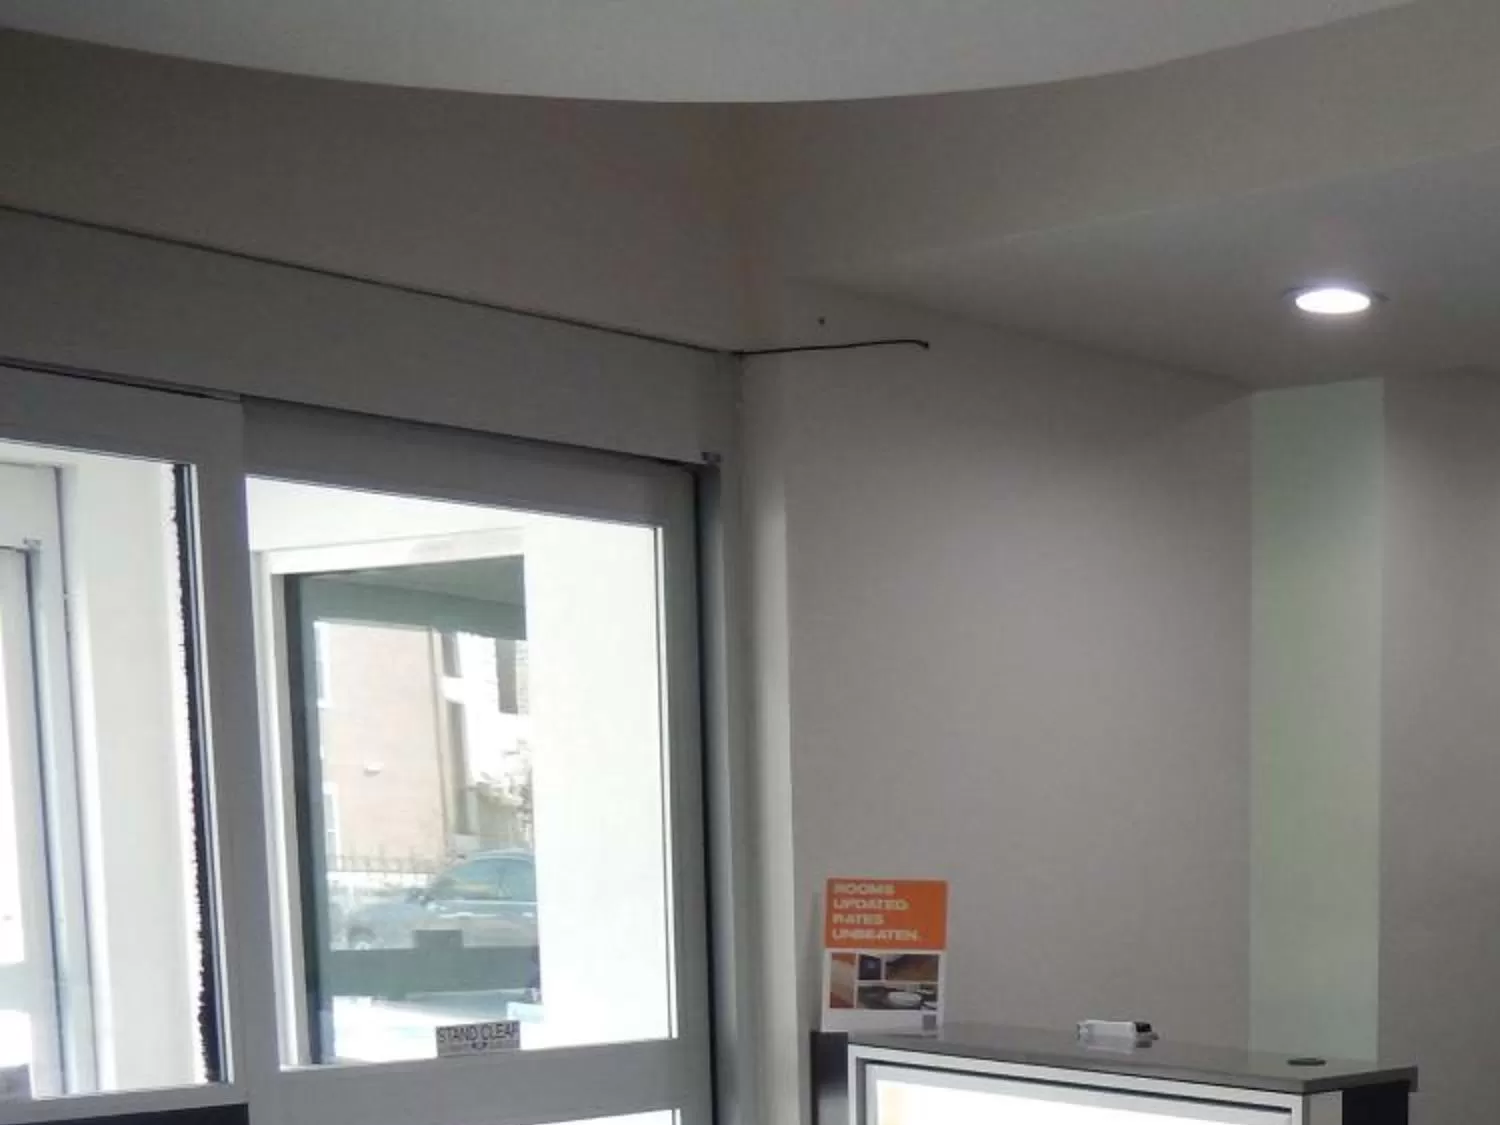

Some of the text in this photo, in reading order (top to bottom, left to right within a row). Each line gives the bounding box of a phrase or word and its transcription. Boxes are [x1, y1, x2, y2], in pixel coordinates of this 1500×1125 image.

[833, 883, 896, 896] ROOMS
[832, 913, 885, 926] RATES
[437, 1025, 478, 1043] STAND
